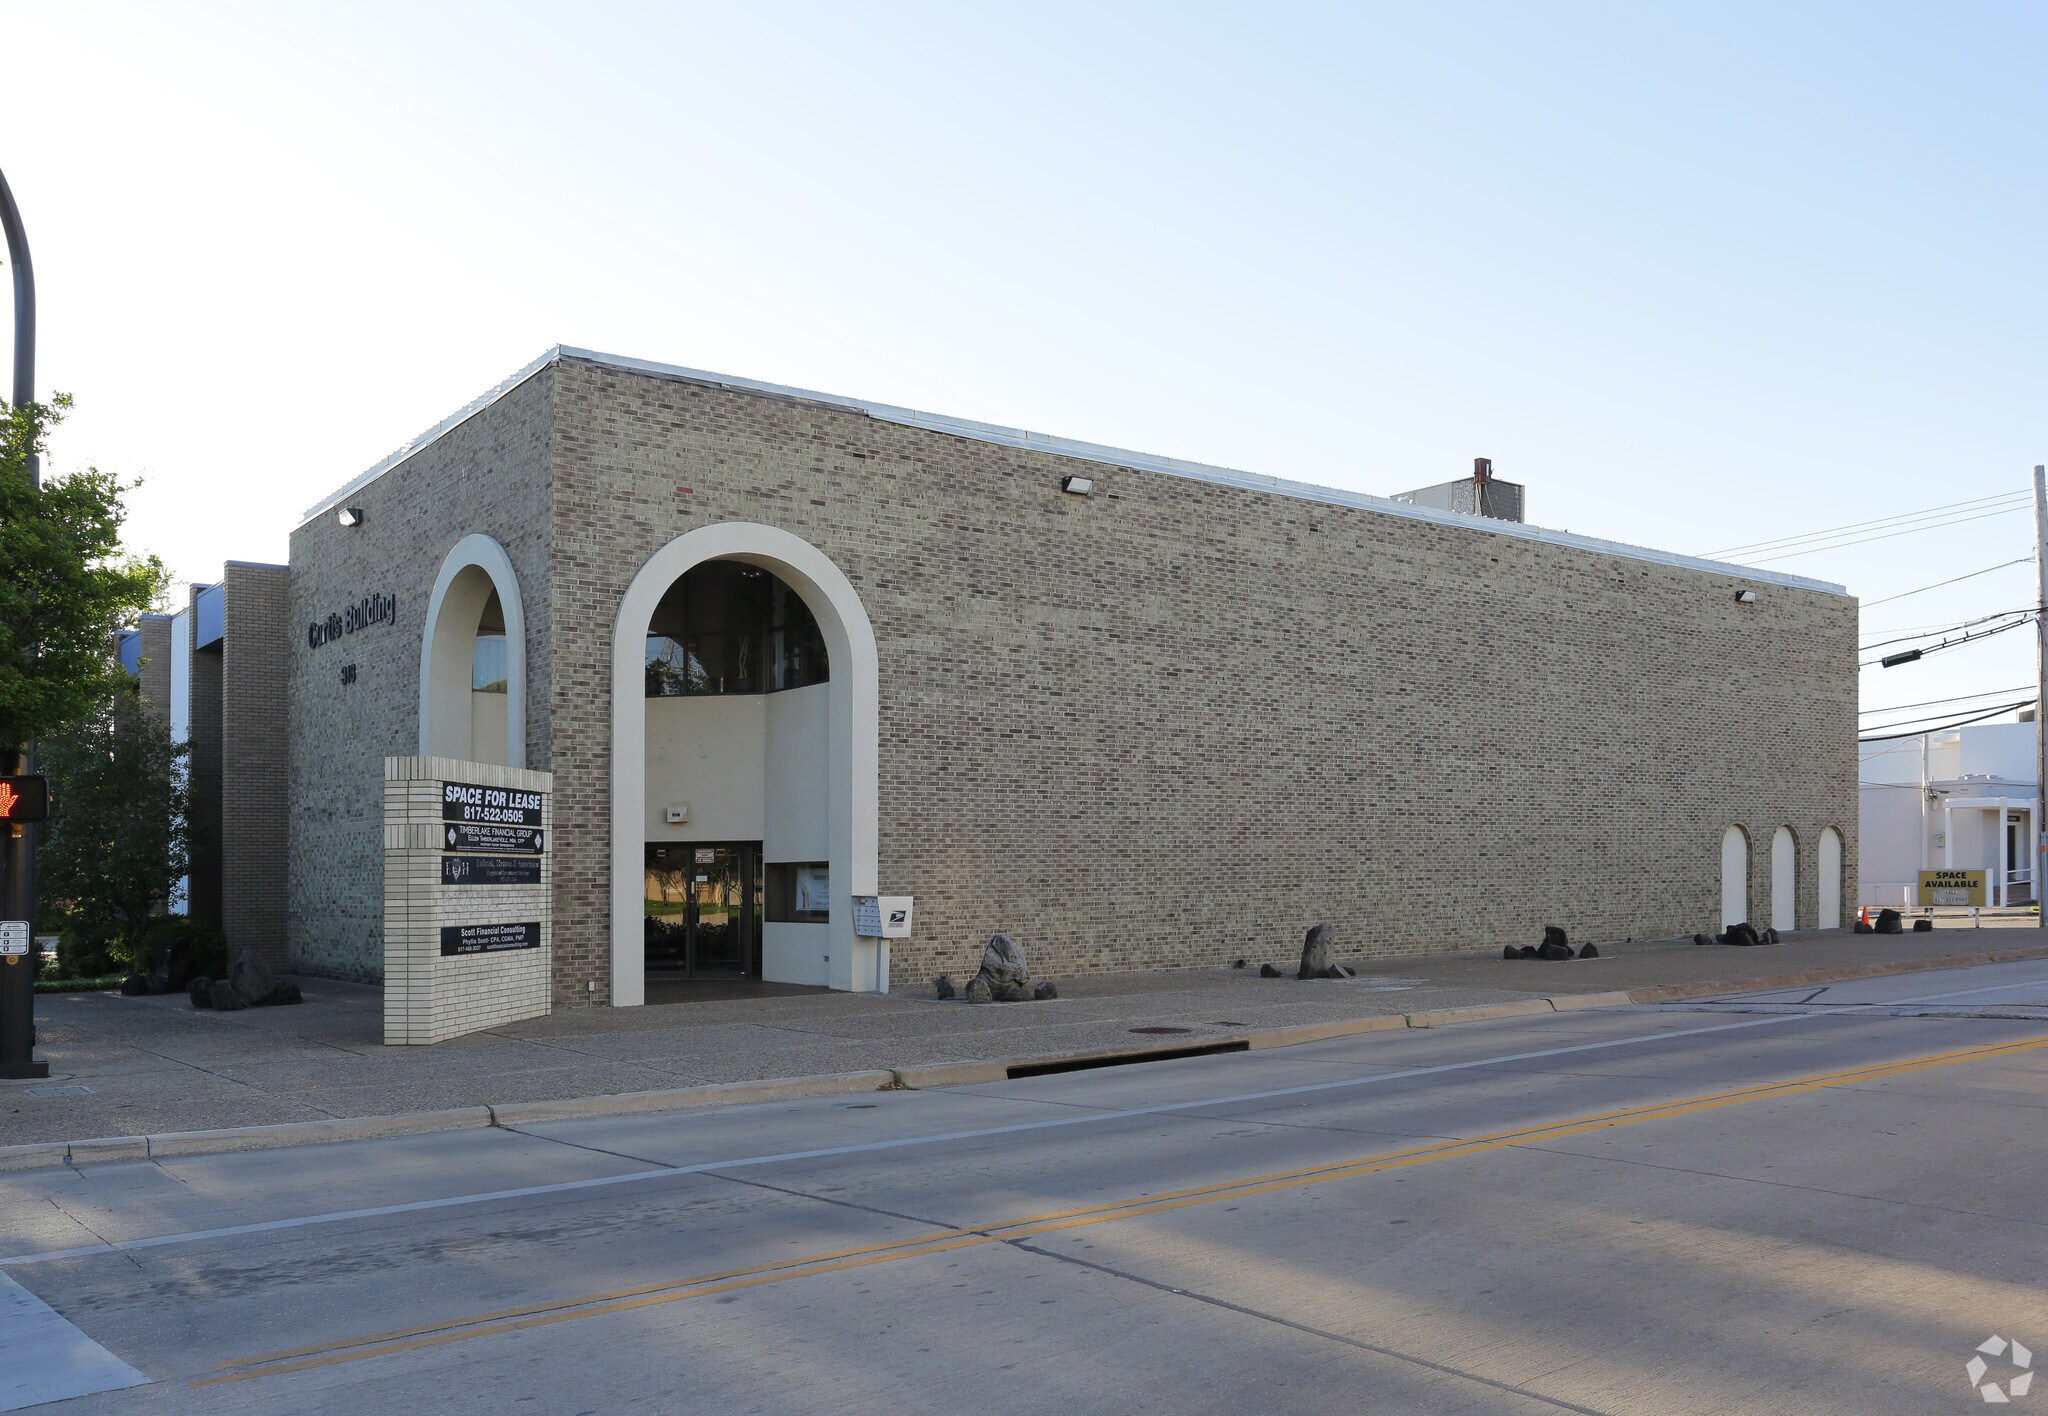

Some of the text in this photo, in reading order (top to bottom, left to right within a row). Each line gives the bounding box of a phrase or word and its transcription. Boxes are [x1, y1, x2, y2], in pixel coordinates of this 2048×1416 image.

[308, 592, 396, 649] Curtis Building
[445, 785, 541, 810] SPACE FOR LEASE
[464, 805, 524, 823] 817-522-0505
[459, 825, 533, 838] TIMBERLAKE FINANCIAL GROUP
[1936, 871, 1967, 879] SPACE
[1924, 880, 1979, 888] AVAILABLE
[461, 925, 526, 937] Scott Financial Consulting
